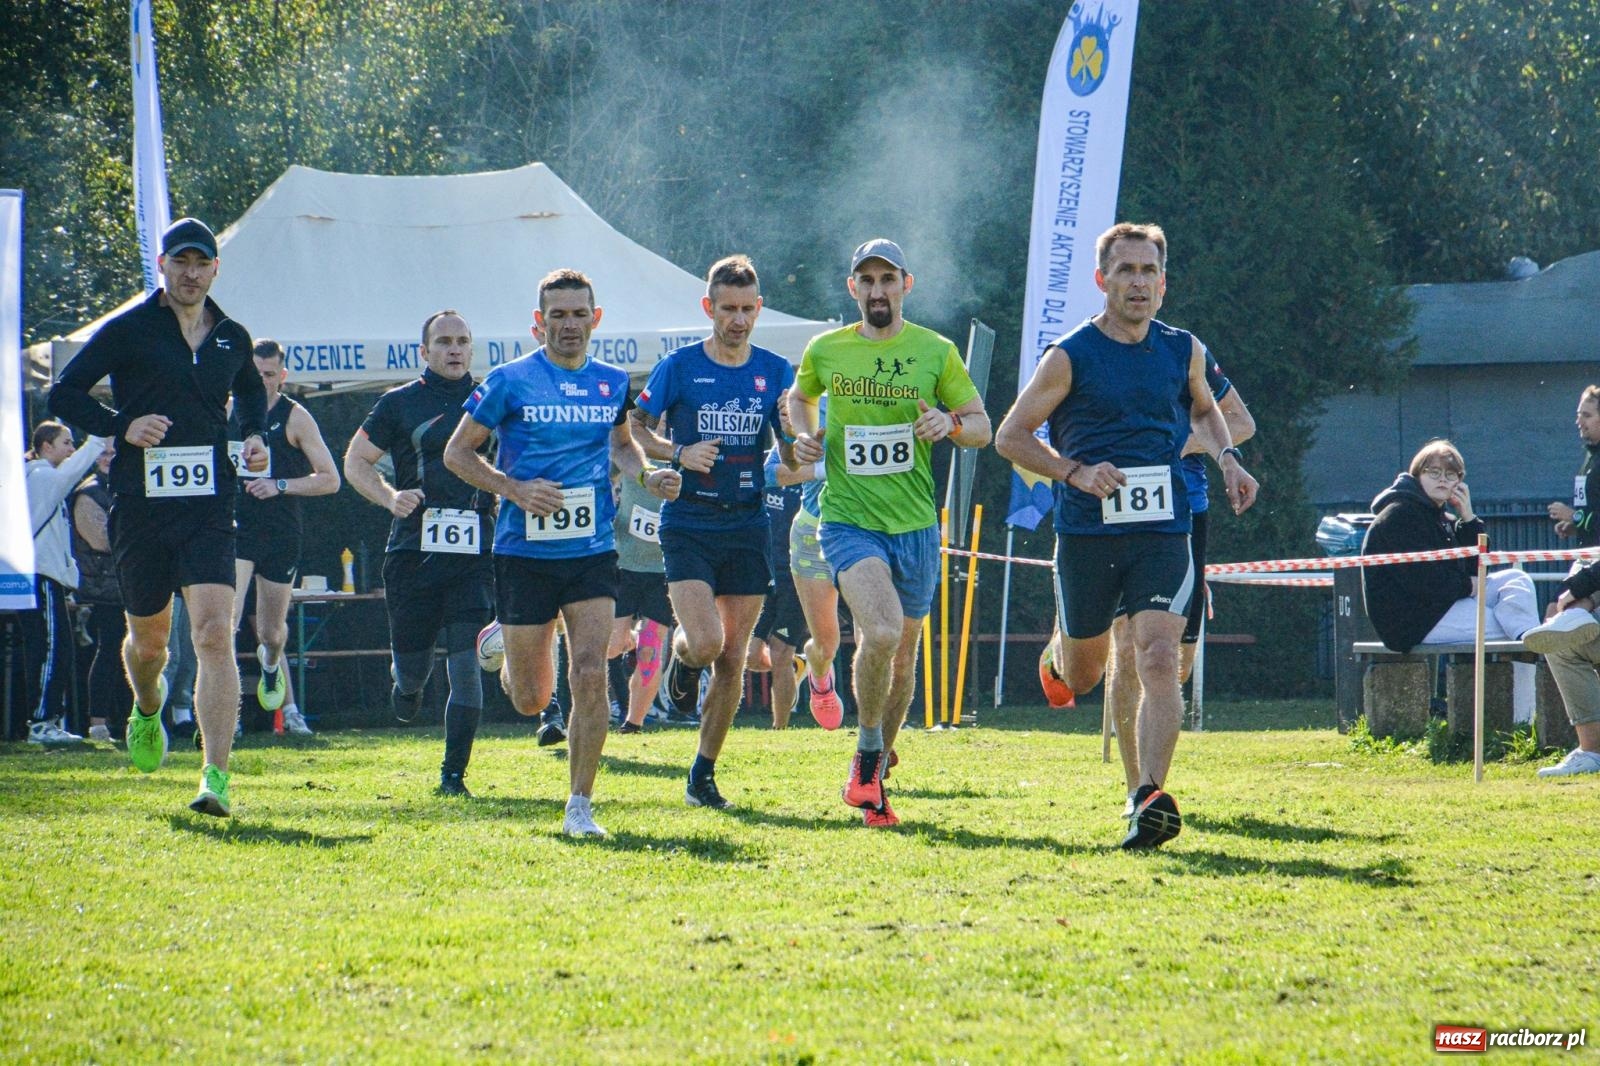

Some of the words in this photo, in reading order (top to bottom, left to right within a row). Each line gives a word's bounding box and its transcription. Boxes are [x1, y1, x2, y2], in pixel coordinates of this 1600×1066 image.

[1055, 109, 1091, 228] STOWARZYSZENIE
[1047, 232, 1074, 293] AKTYWNI
[1041, 298, 1066, 324] DLA
[832, 372, 919, 399] Radlinioki
[700, 413, 761, 432] SILESIAN
[849, 441, 910, 466] 308
[150, 464, 209, 487] 199
[1107, 485, 1165, 512] 181
[531, 506, 591, 530] 198
[427, 523, 474, 546] 161
